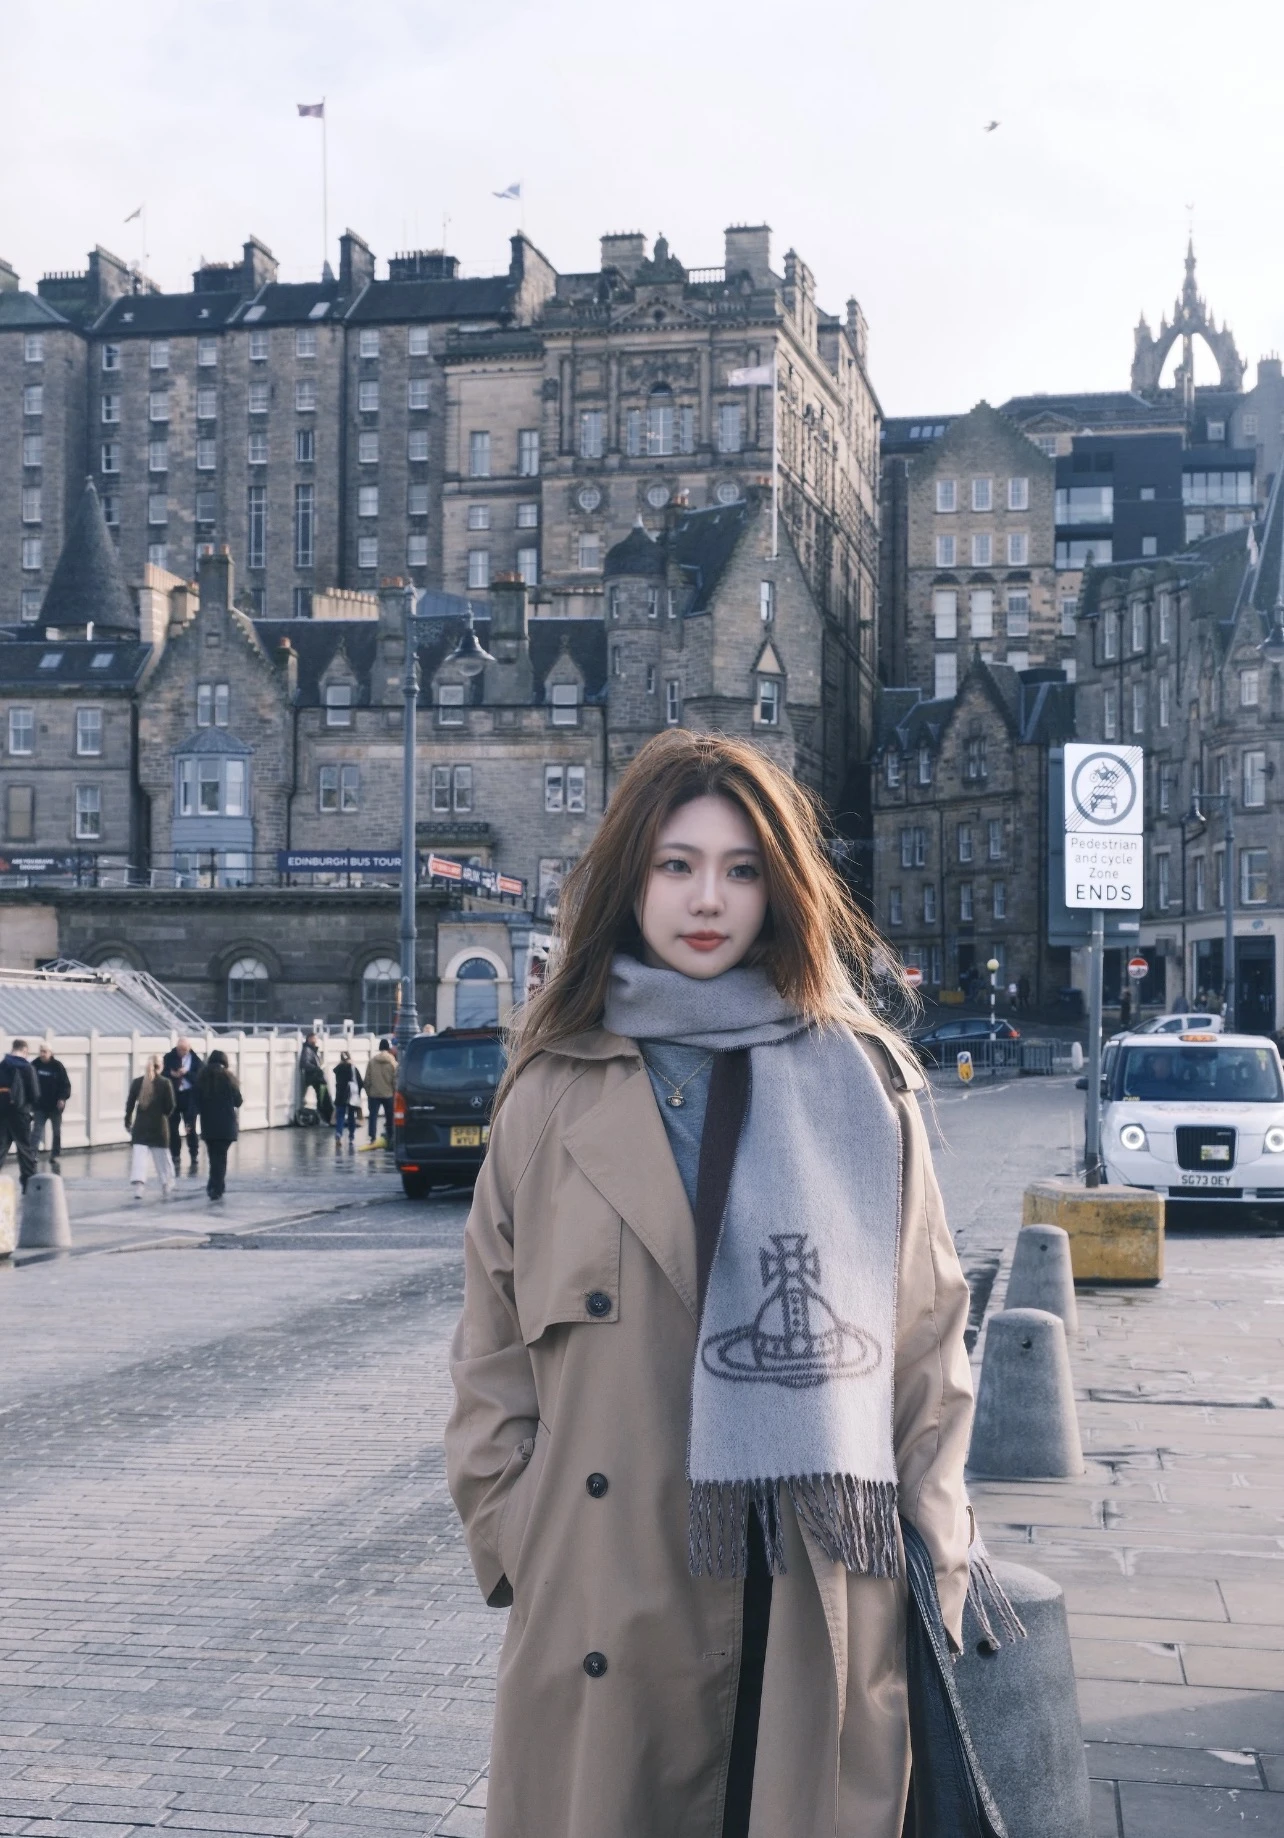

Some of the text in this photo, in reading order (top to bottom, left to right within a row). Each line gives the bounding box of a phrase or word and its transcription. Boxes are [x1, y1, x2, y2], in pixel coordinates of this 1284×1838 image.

[1071, 838, 1137, 850] Pedestrian
[287, 856, 348, 866] EDINBURGH
[350, 857, 371, 867] BUS
[1075, 854, 1133, 866] and cycle
[1089, 867, 1119, 879] Zone
[1076, 884, 1132, 901] ENDS
[1181, 1174, 1209, 1185] SG73
